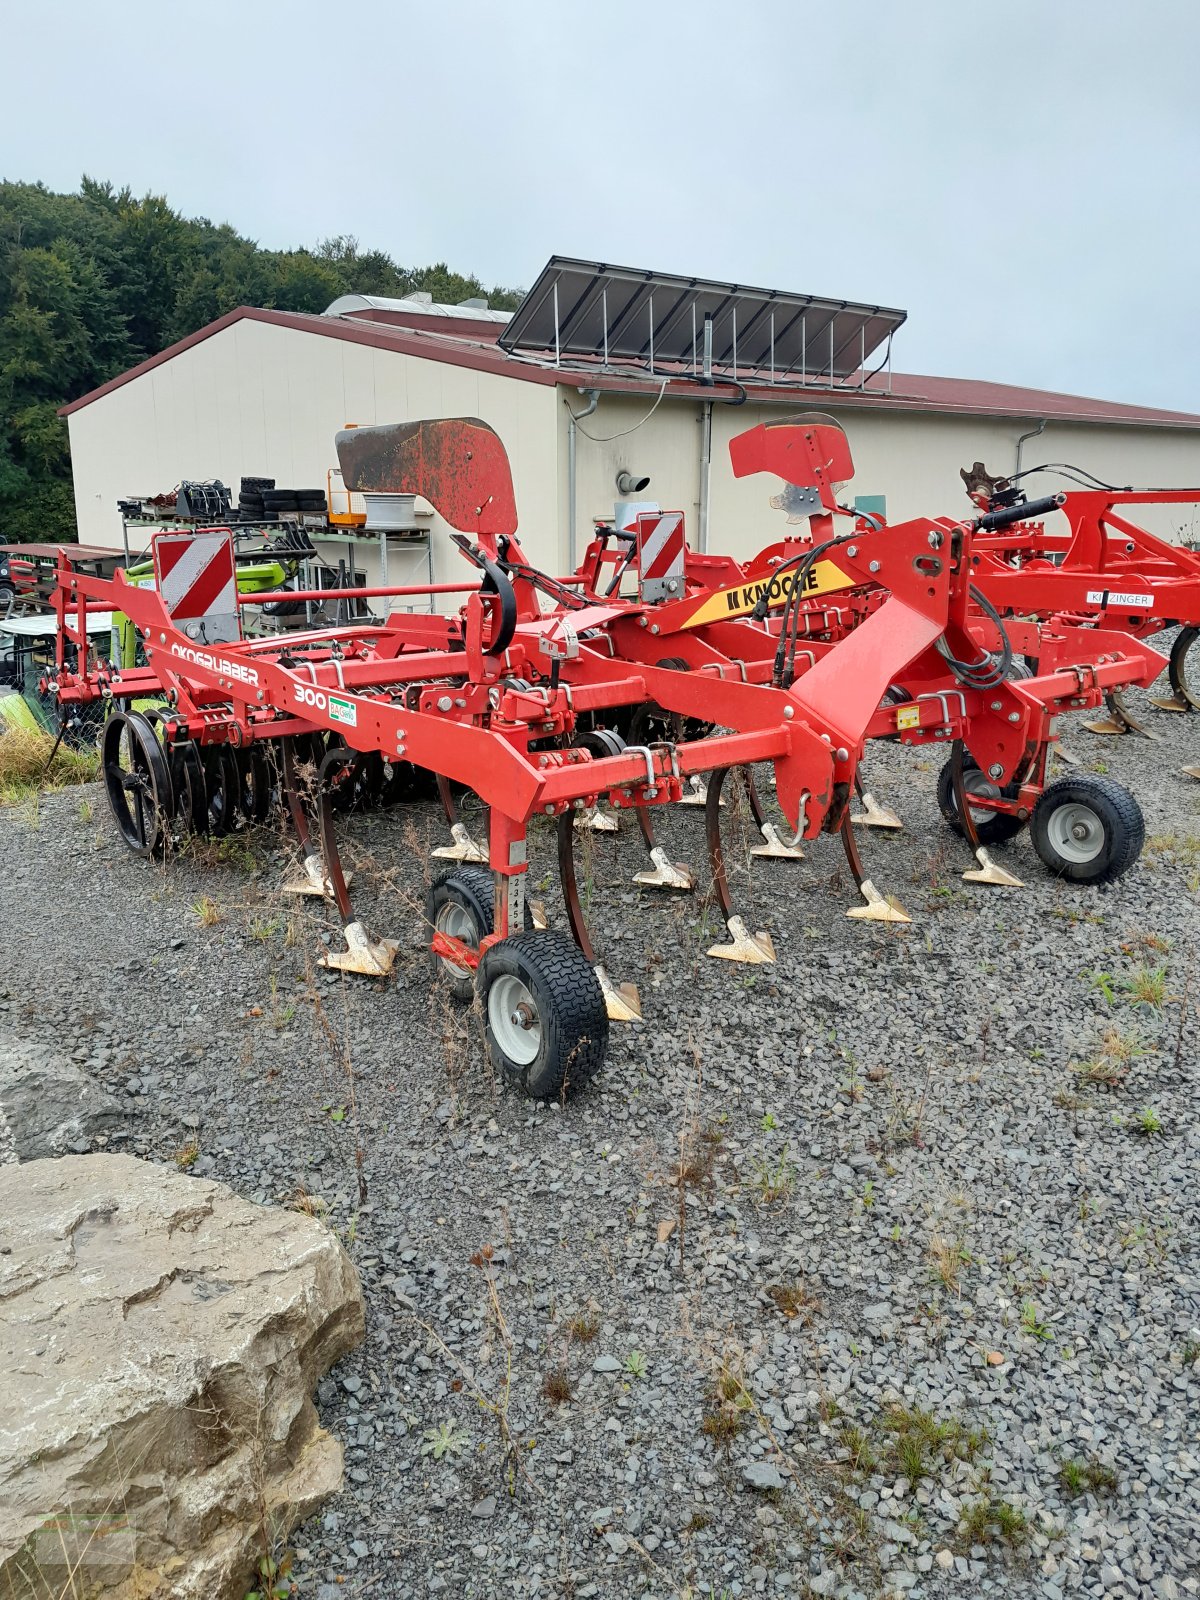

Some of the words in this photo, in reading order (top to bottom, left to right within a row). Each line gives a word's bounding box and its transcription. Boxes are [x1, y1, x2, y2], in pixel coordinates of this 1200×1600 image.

[1092, 593, 1148, 605] KIZINGER
[293, 684, 326, 710] 300
[514, 878, 519, 887] 2
[514, 889, 519, 897] 3
[513, 900, 519, 908] 4
[513, 910, 519, 919] 5
